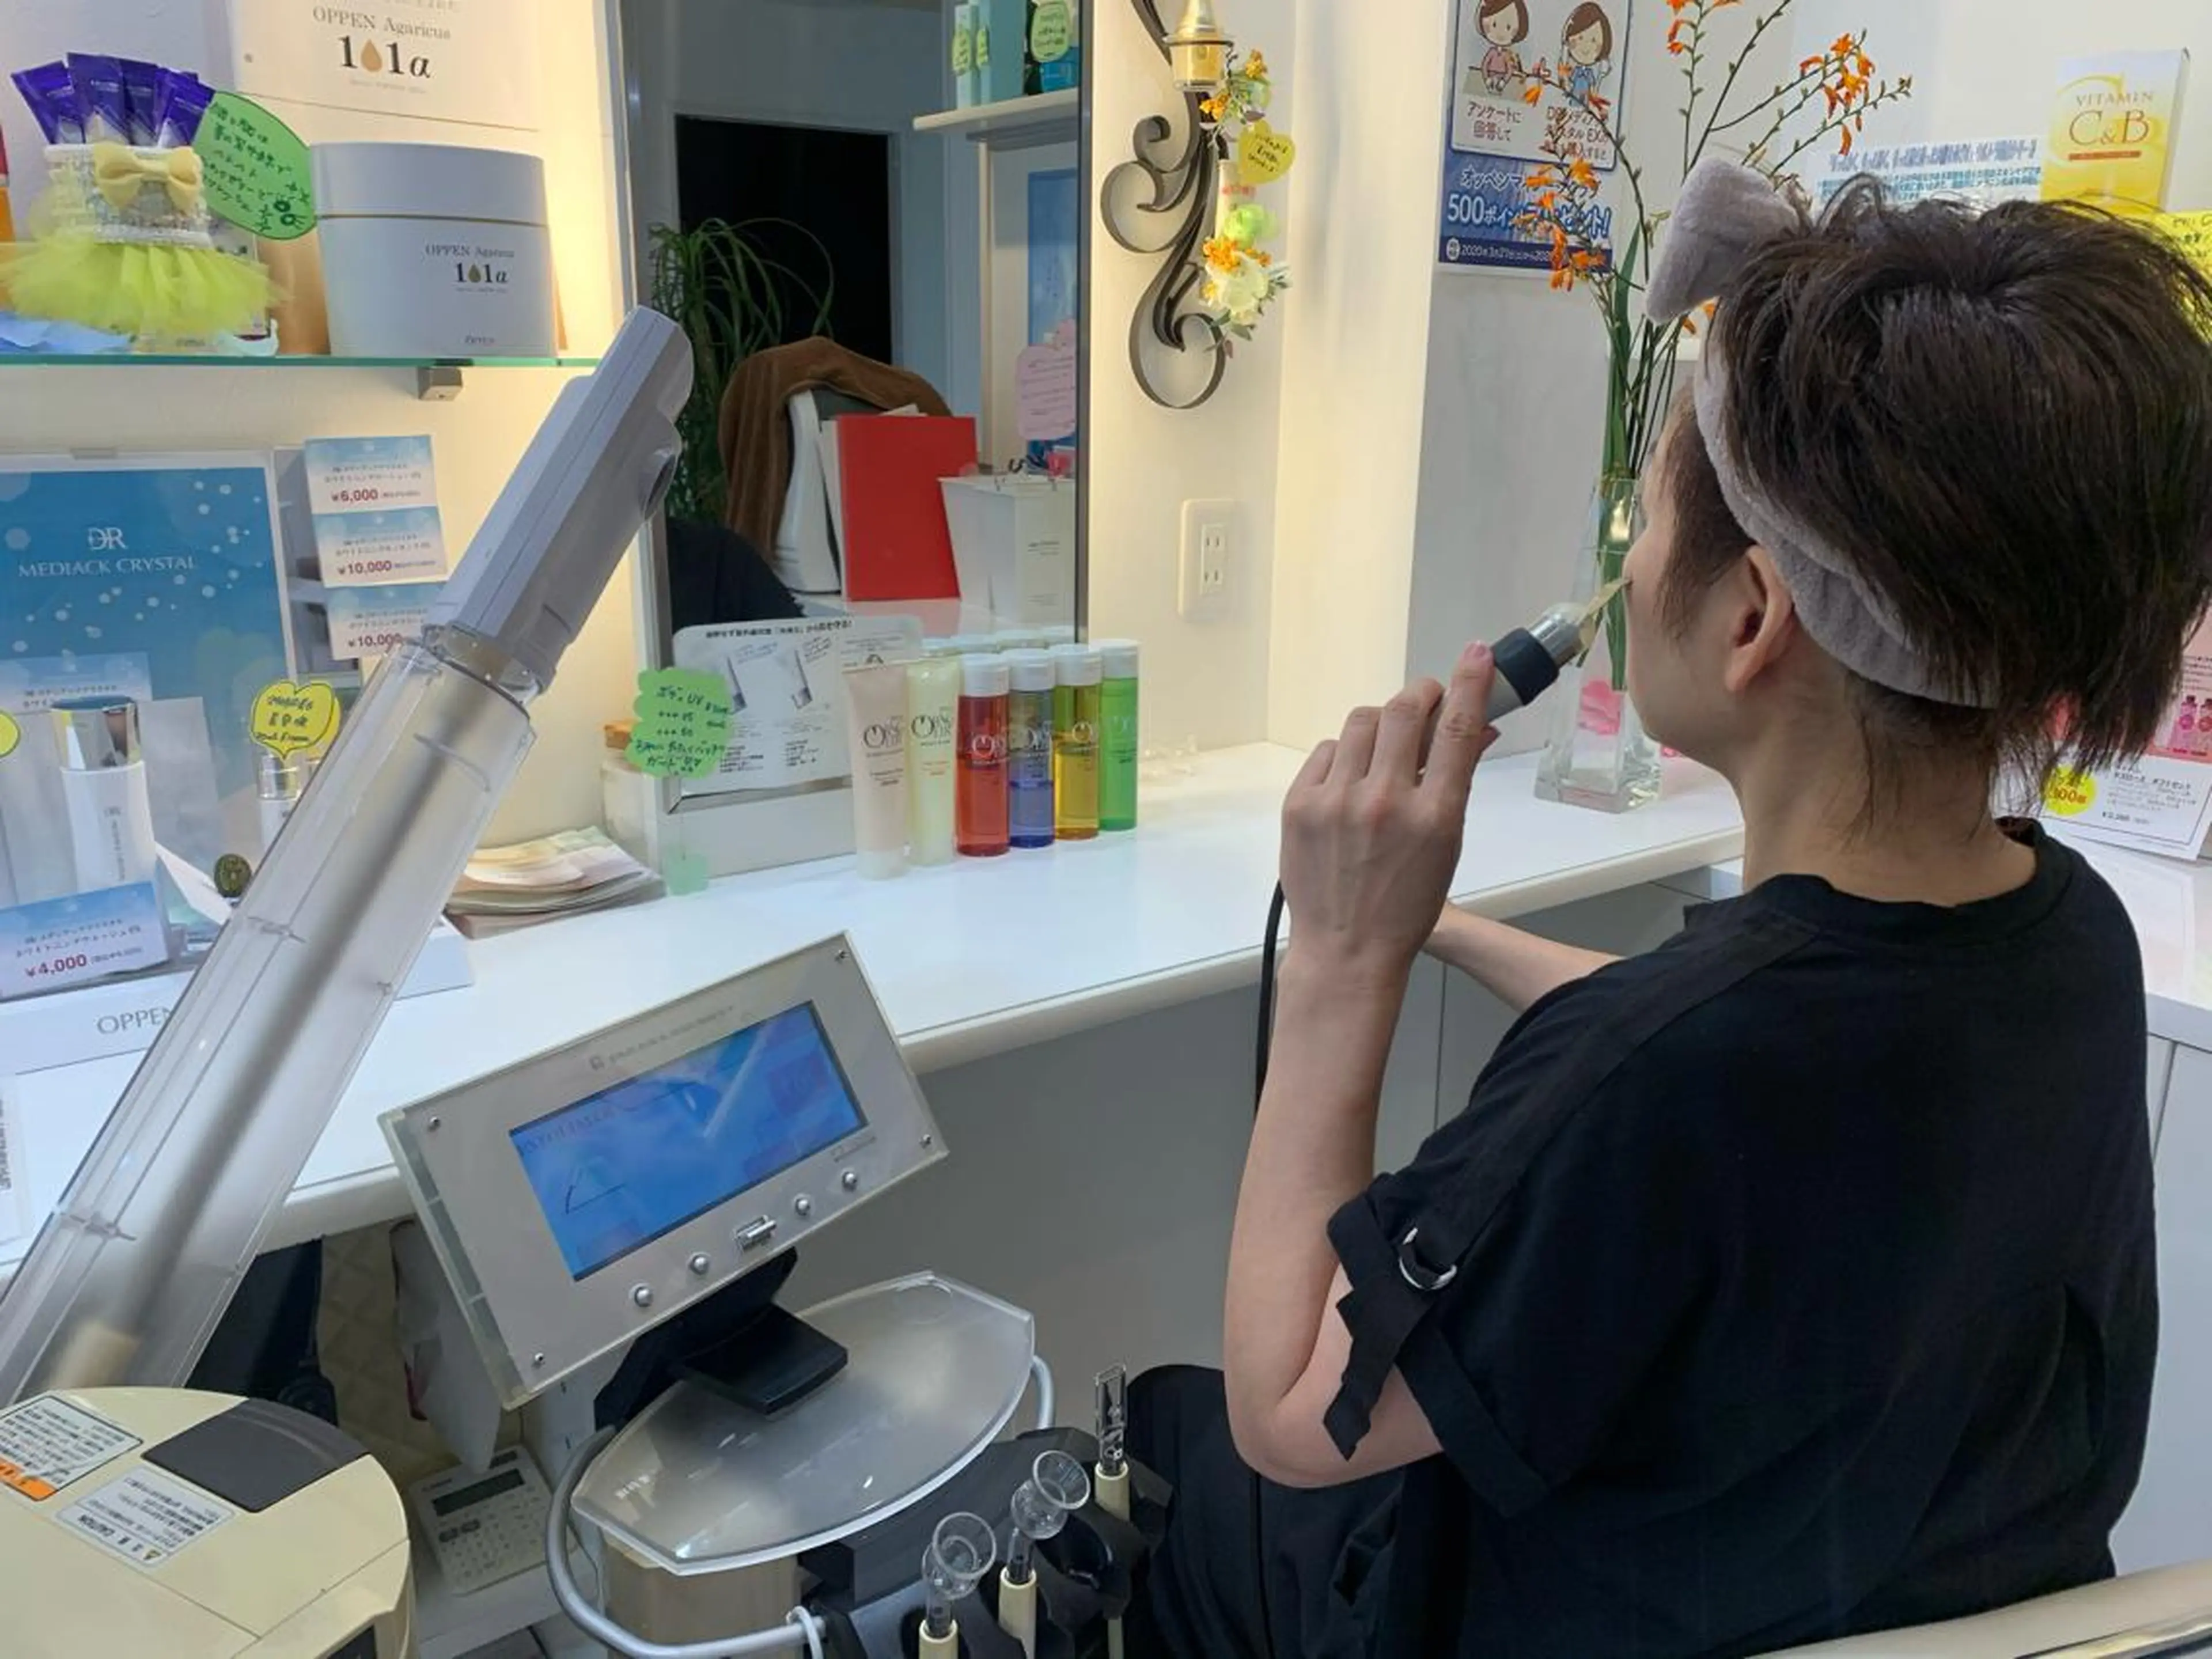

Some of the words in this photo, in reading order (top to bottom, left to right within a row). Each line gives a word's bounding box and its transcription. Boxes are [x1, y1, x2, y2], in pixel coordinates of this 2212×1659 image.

[313, 6, 376, 30] OPPEN
[2076, 90, 2154, 107] VITAMIN
[18, 558, 111, 578] MEDIACK
[115, 555, 195, 574] CRYSTAL
[25, 954, 87, 979] ¥4,000
